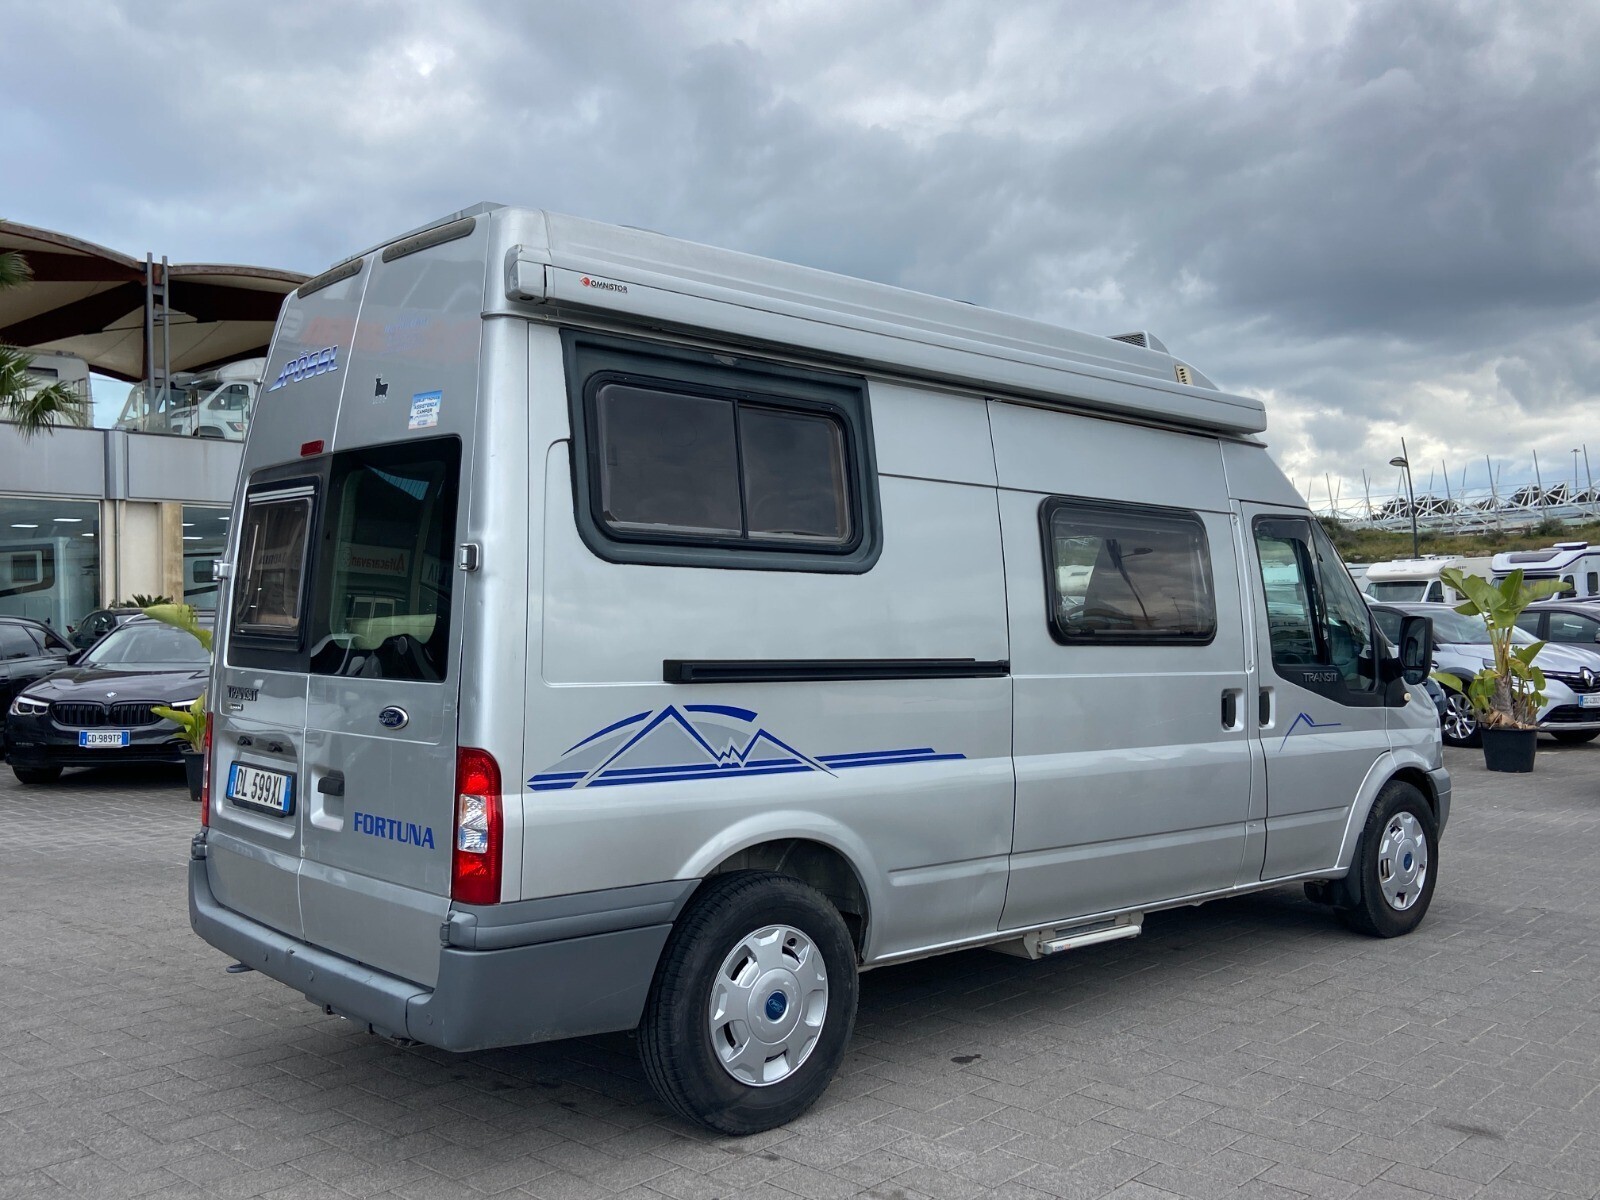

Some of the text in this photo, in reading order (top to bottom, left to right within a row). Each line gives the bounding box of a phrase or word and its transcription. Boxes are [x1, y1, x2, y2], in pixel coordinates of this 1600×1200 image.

[590, 280, 628, 294] OMNISTOR
[1302, 672, 1339, 682] TRANSIT
[226, 684, 260, 702] TRANSIT
[235, 768, 282, 807] DL 599XL
[354, 811, 435, 850] FORTUNA
